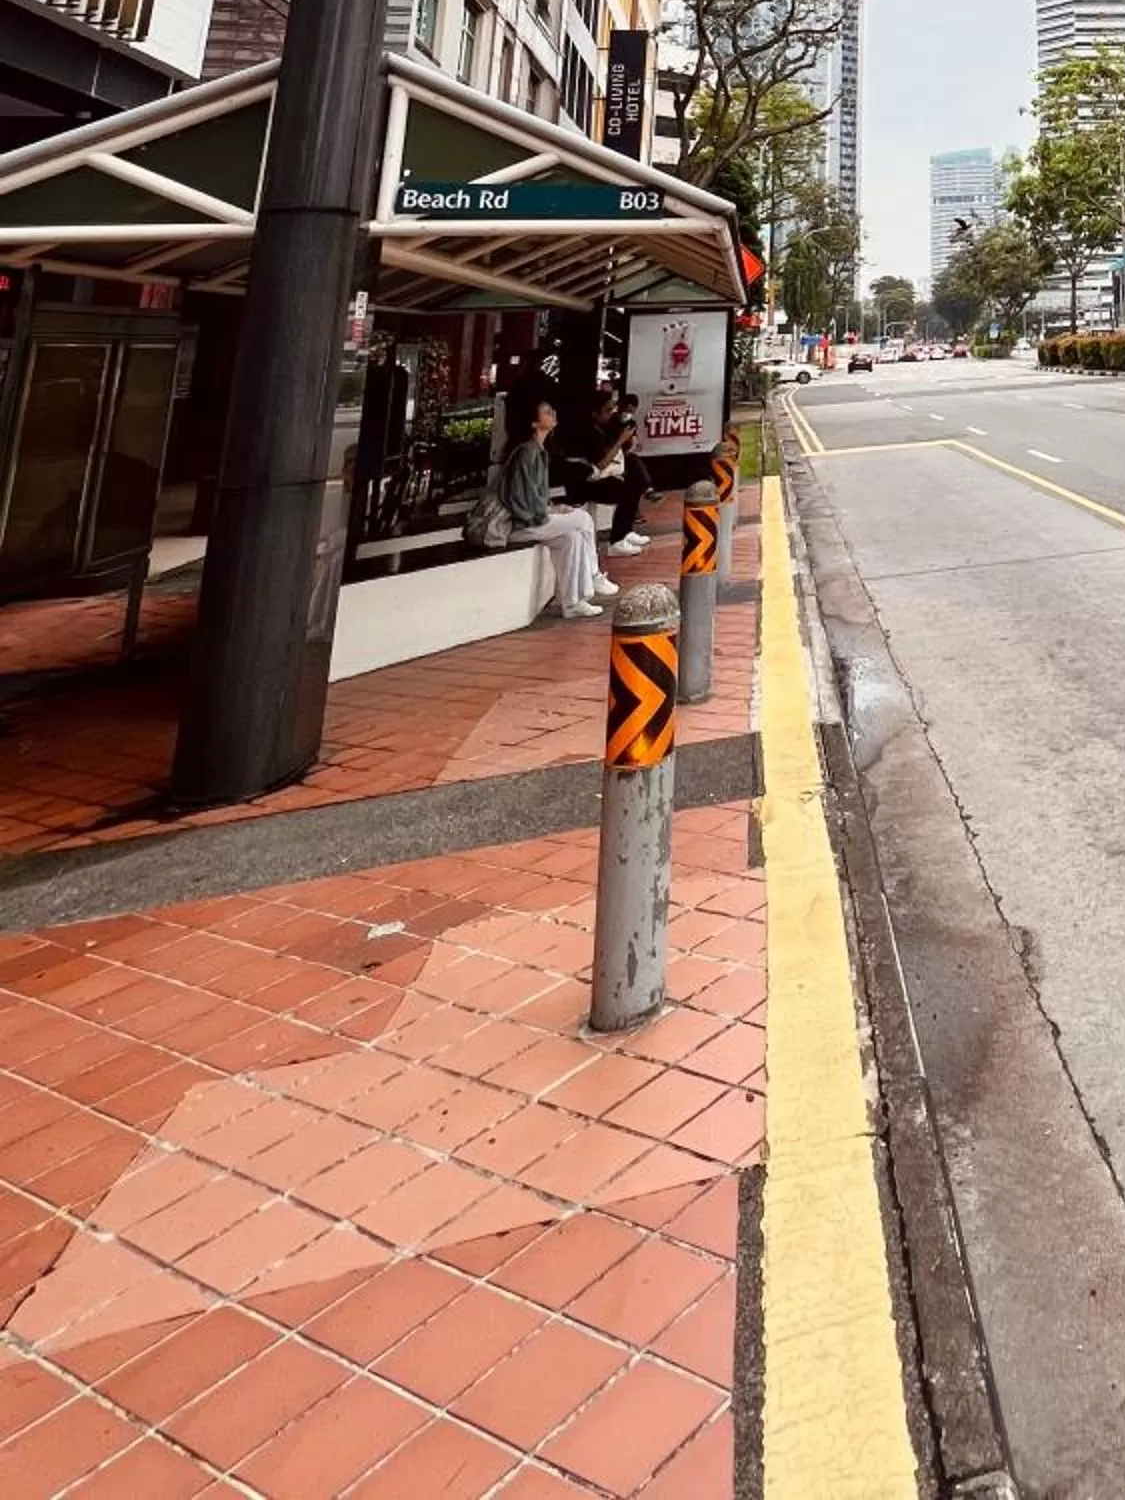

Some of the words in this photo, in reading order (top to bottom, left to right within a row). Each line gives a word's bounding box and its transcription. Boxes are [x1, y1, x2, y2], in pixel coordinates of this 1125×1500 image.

[607, 63, 625, 136] CO-LIVING
[625, 79, 641, 122] HOTEL
[402, 188, 470, 209] Beach
[479, 190, 509, 209] Rd
[619, 191, 660, 210] B03
